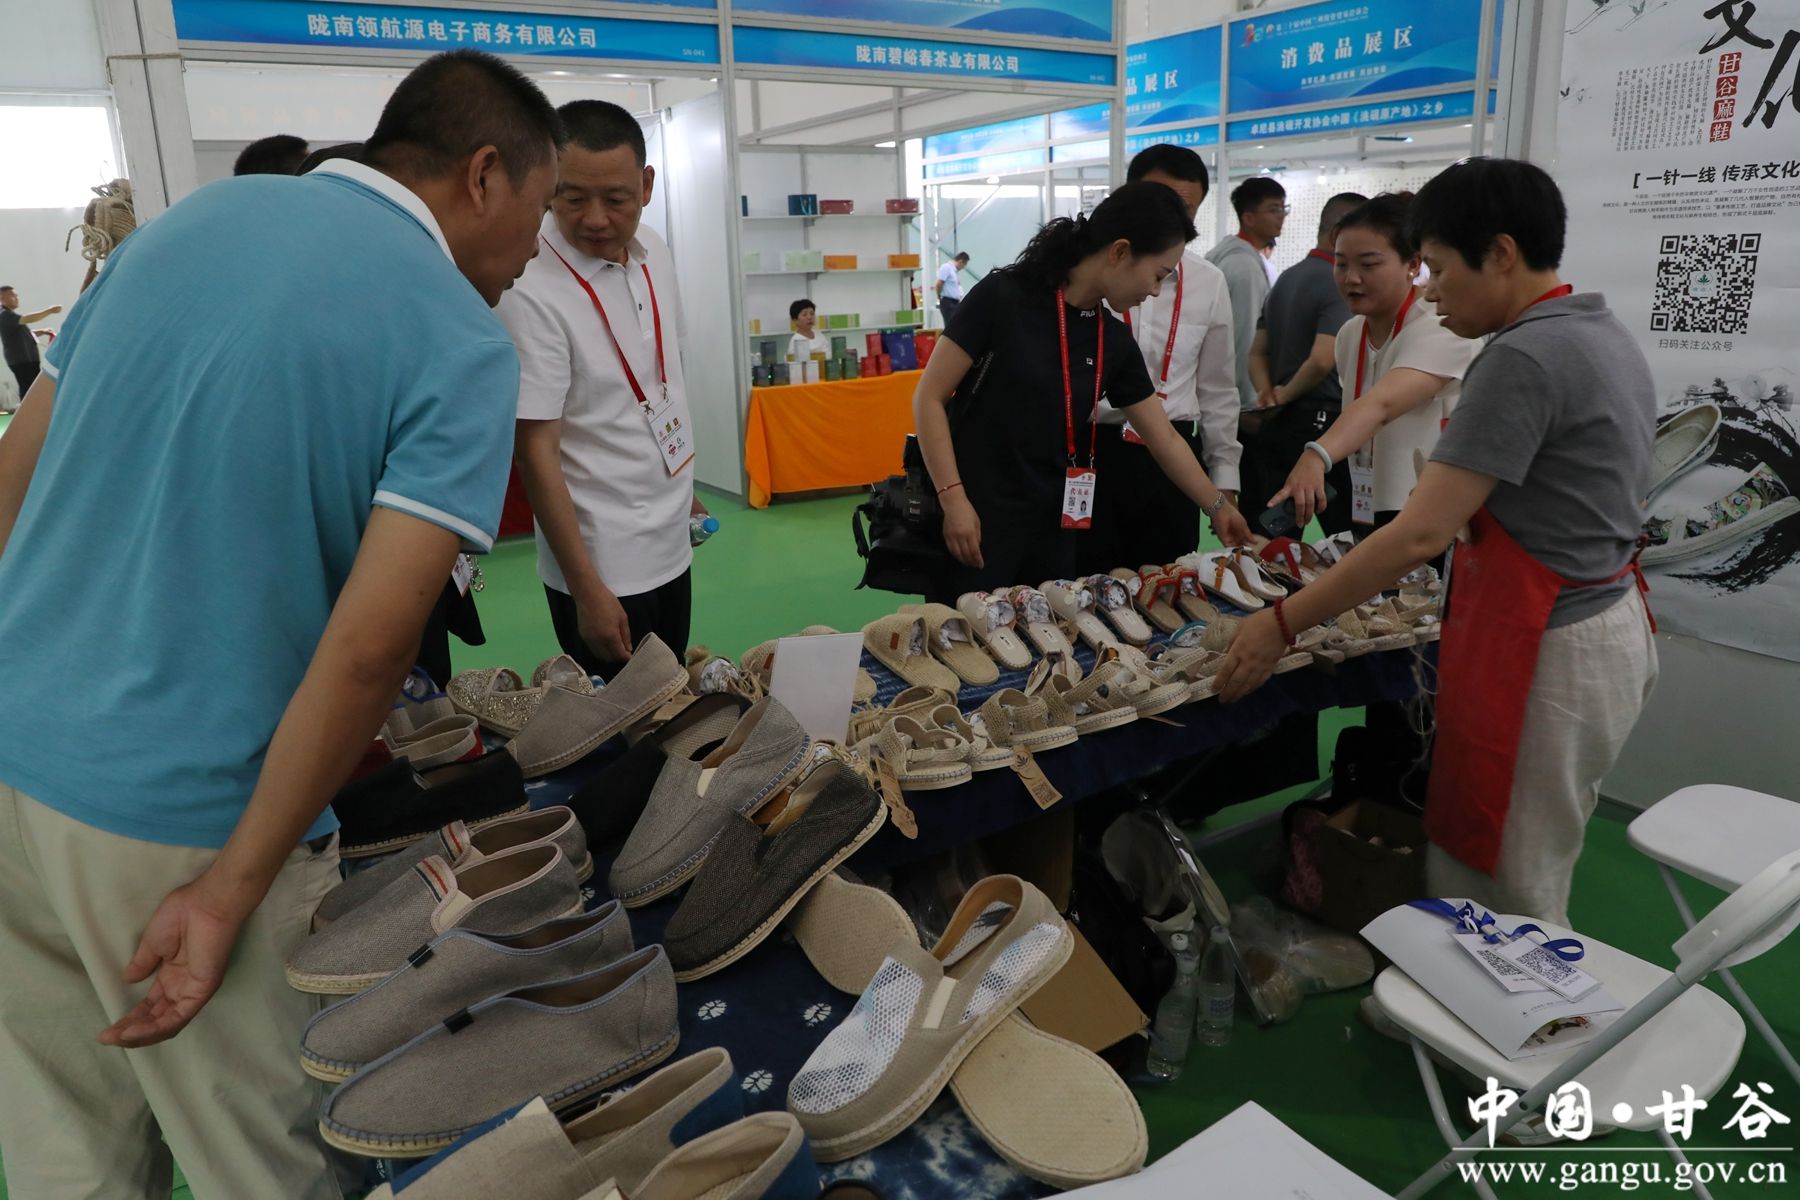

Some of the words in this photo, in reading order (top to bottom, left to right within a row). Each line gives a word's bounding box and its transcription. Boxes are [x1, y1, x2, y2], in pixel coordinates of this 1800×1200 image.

[307, 13, 597, 48] 陇南领航源电子商务有限公司
[856, 45, 1019, 73] 陇南碧峪春茶业有限公司
[1281, 25, 1414, 70] 消费品展区
[1709, 52, 1742, 142] 甘谷麻鞋
[1722, 160, 1800, 183] 传承文化
[1658, 339, 1733, 352] 扫码关注公众号
